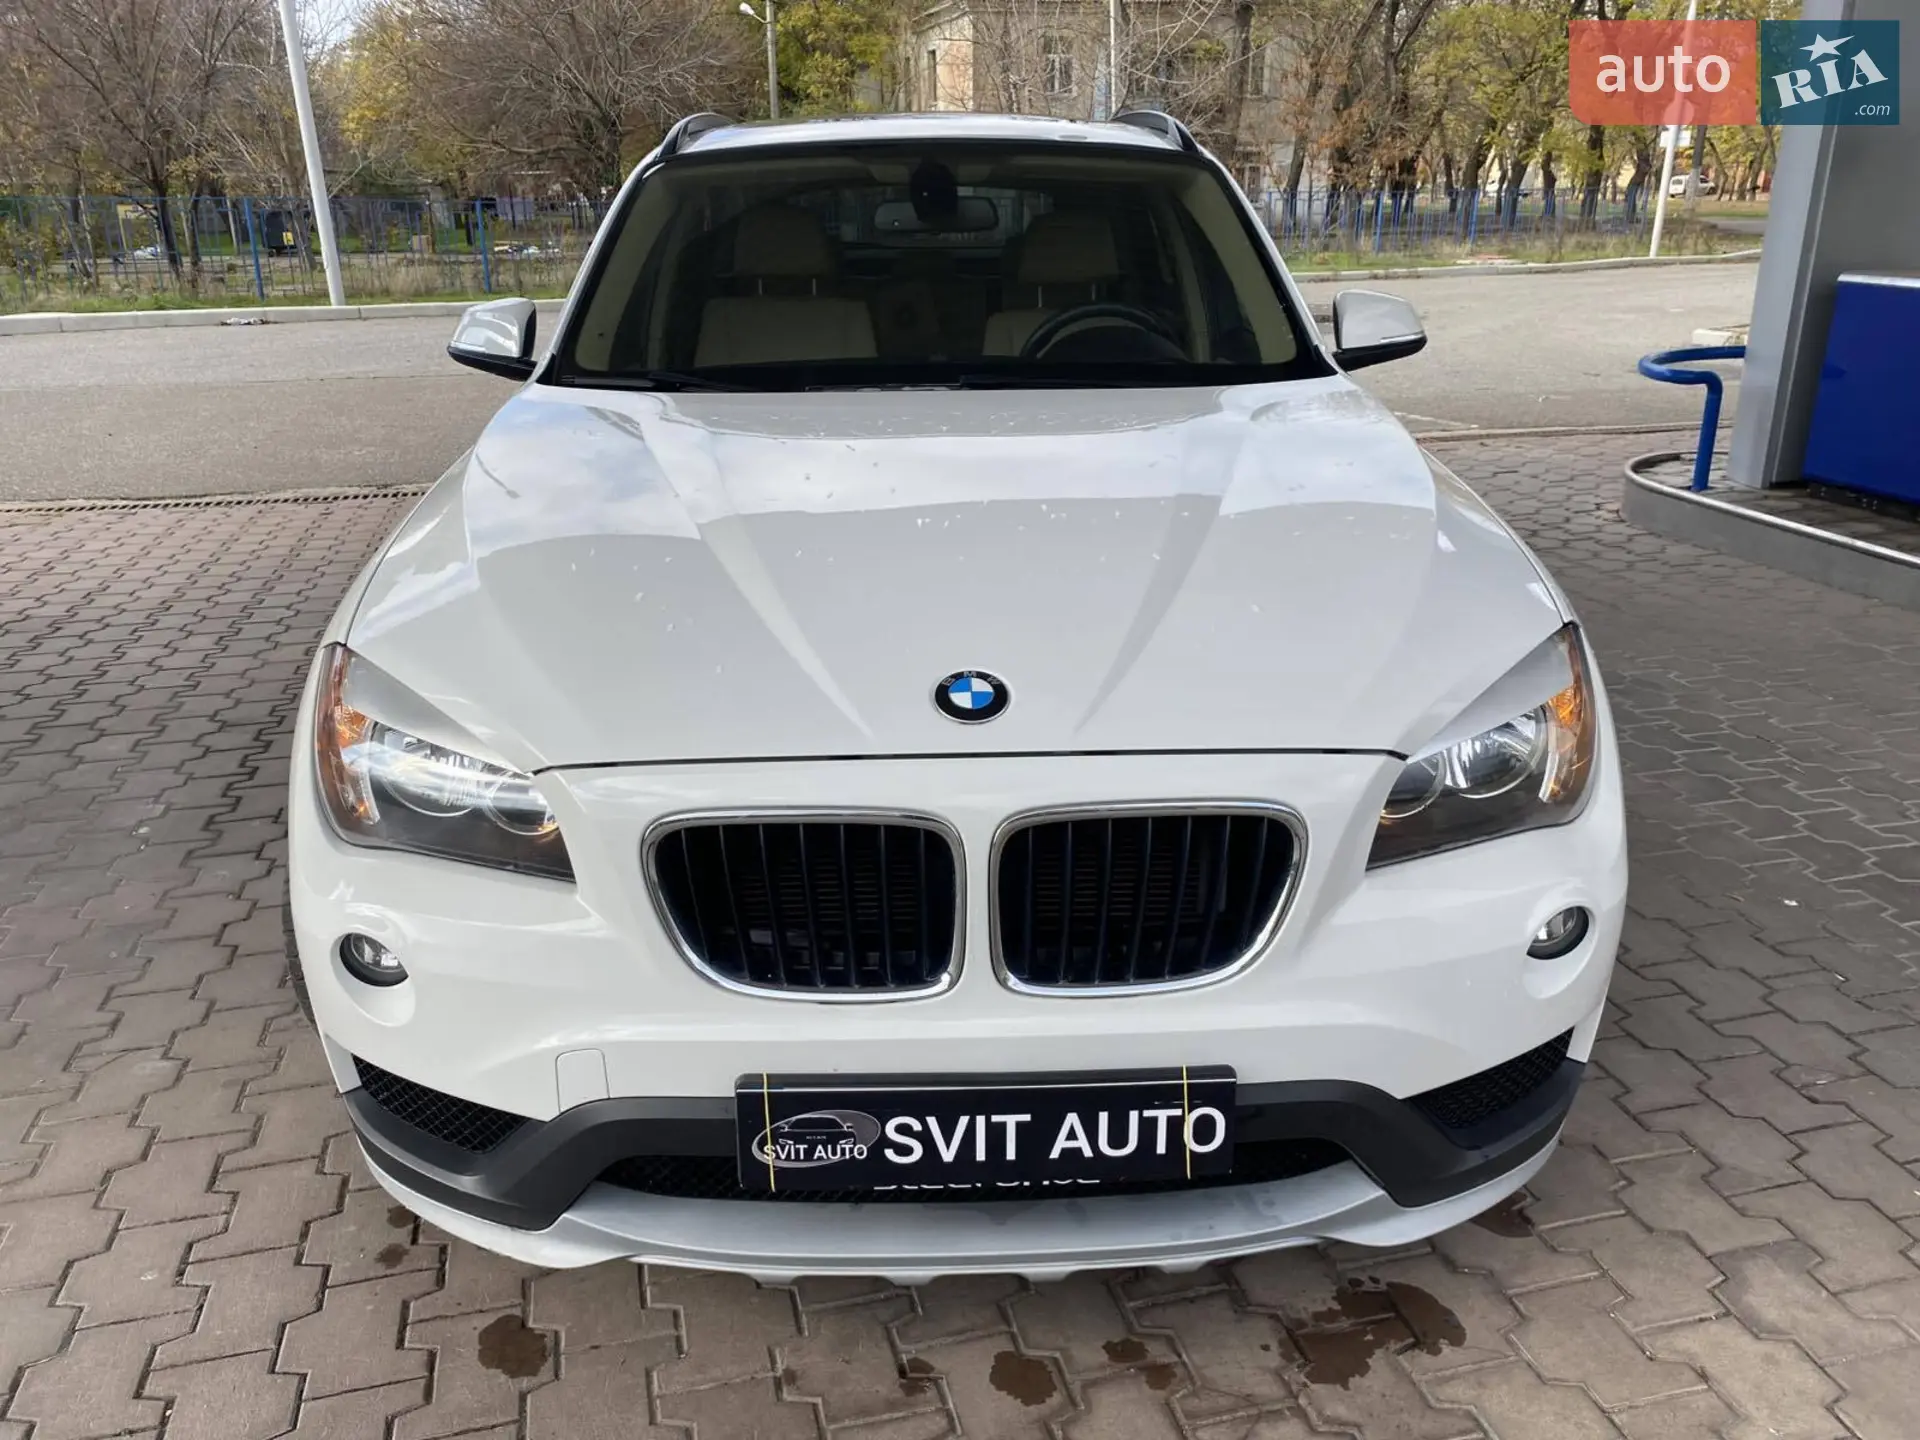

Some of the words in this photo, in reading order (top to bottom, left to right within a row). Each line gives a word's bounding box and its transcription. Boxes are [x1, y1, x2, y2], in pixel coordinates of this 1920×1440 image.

[941, 671, 1001, 685] BMW
[884, 1114, 1032, 1164] SVIT
[1049, 1106, 1227, 1160] AUTO
[763, 1144, 808, 1160] SVIT
[813, 1144, 868, 1160] AUTO
